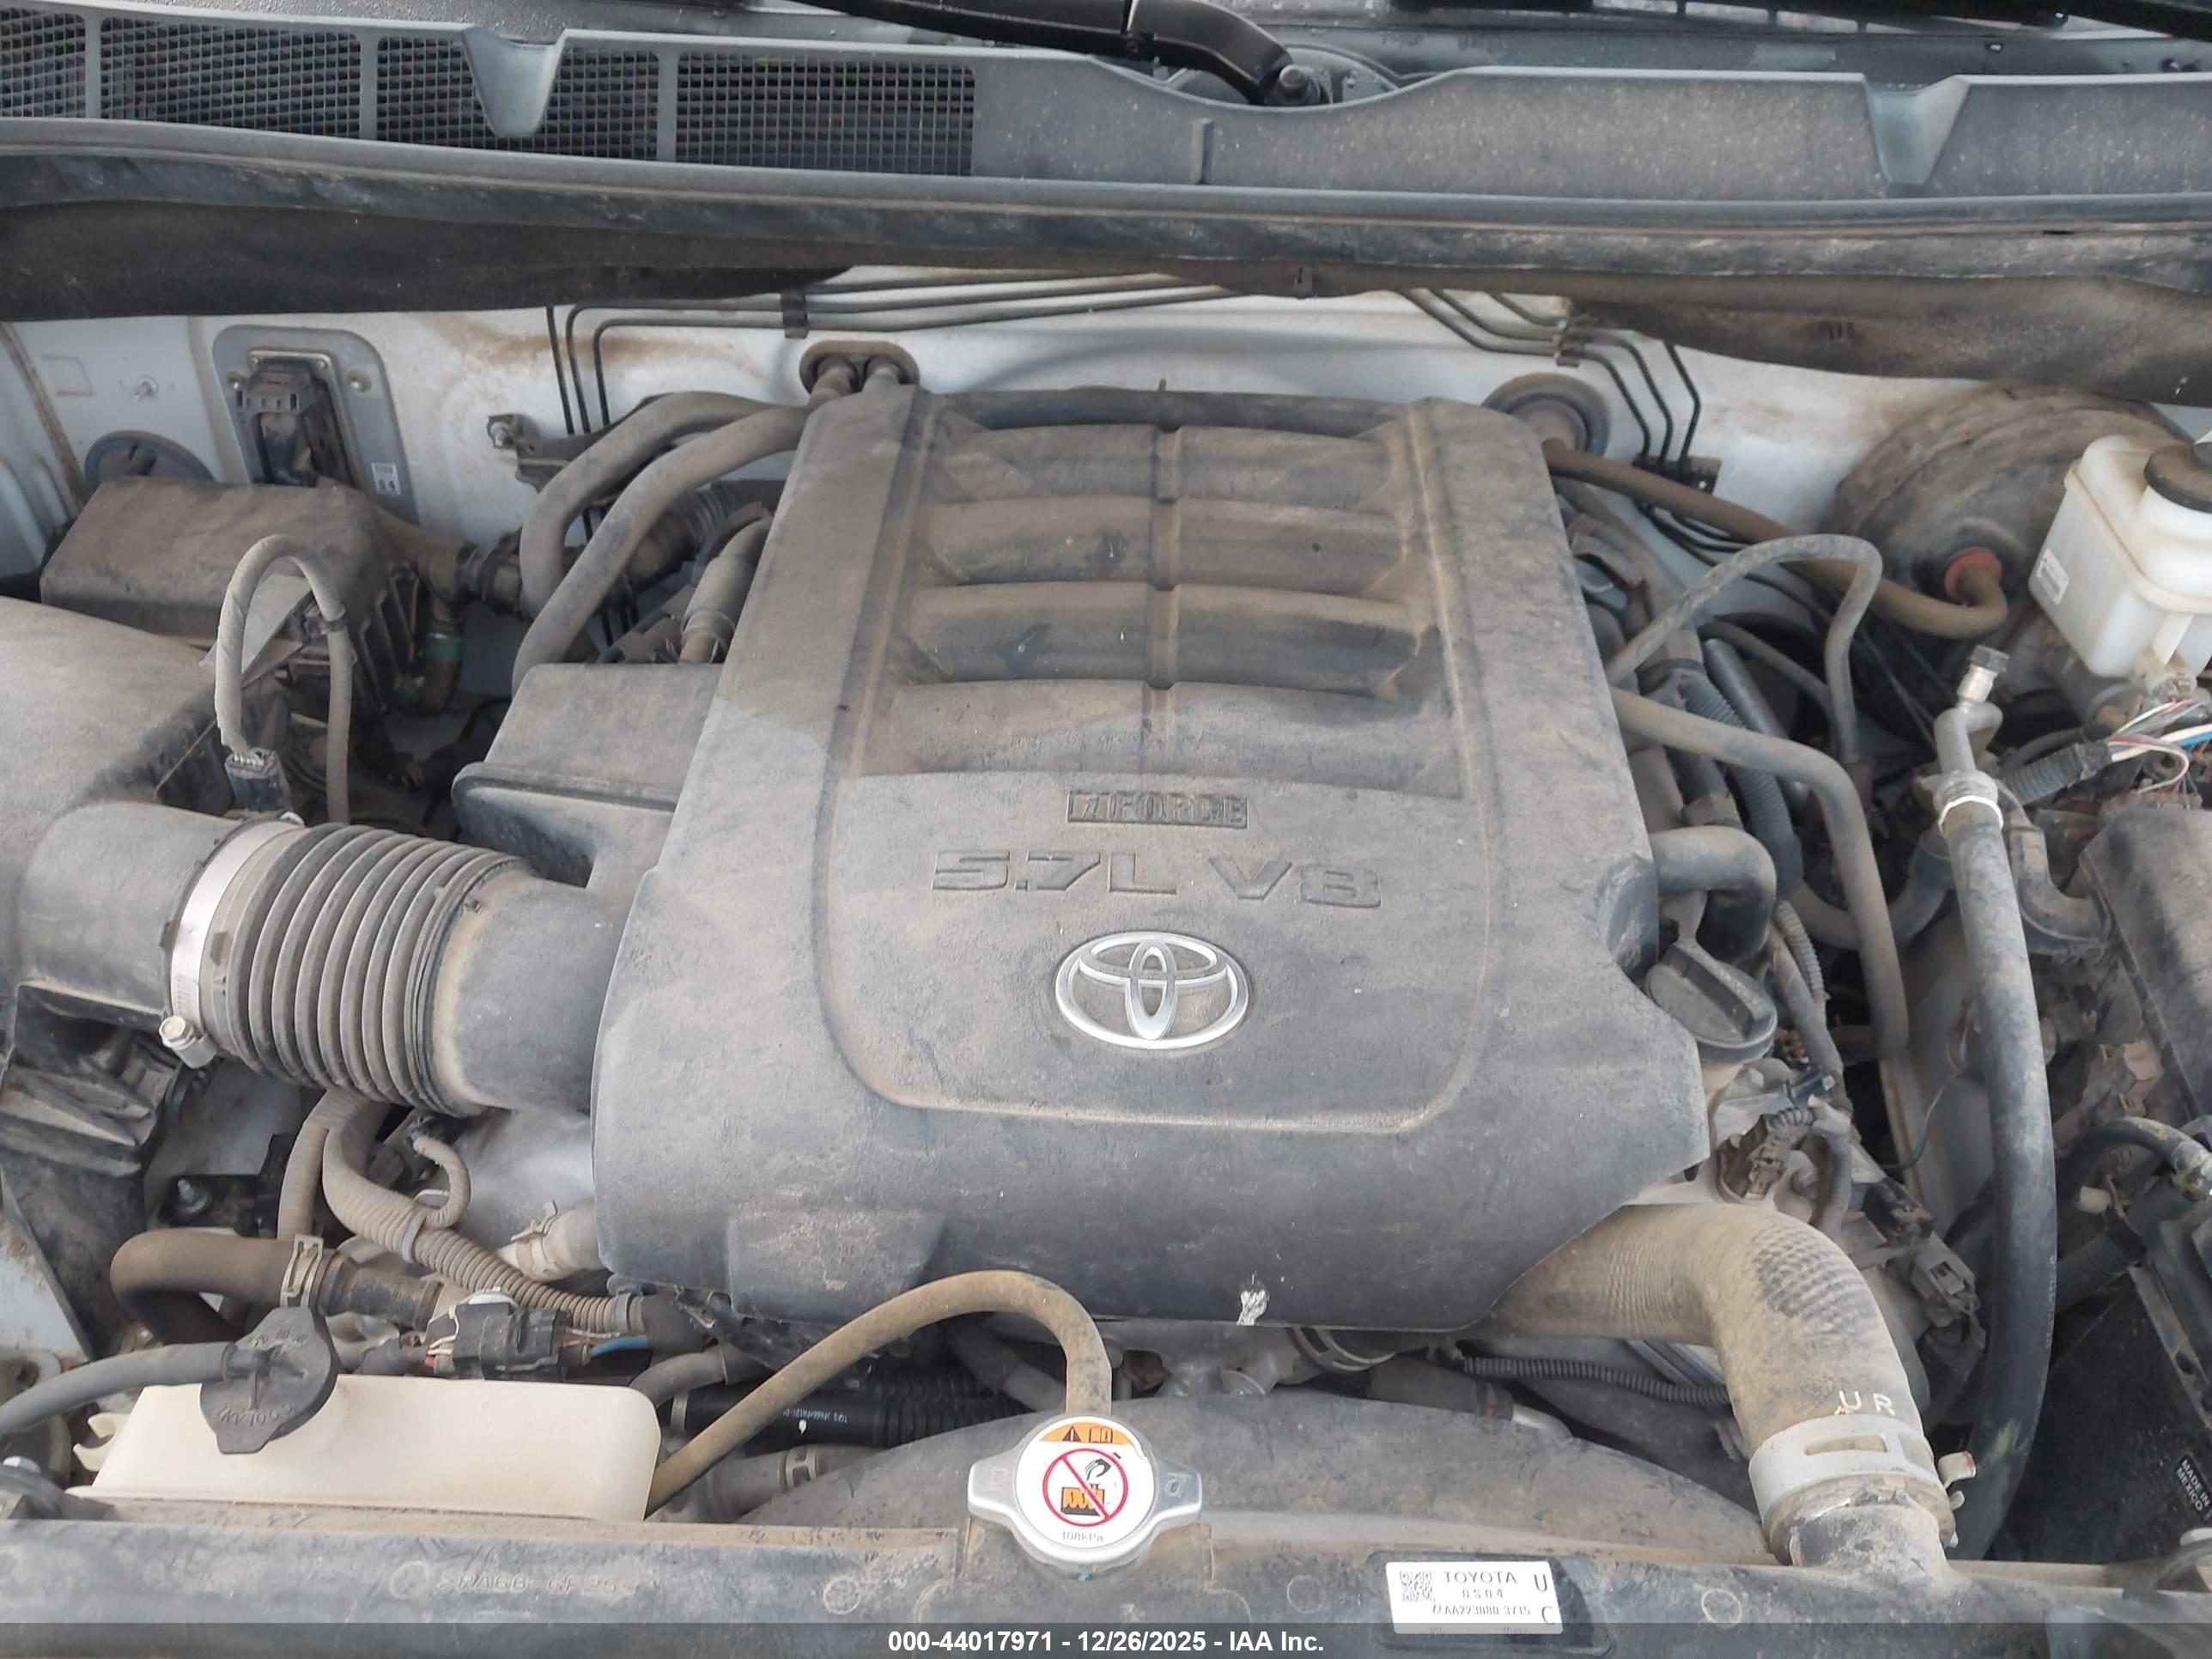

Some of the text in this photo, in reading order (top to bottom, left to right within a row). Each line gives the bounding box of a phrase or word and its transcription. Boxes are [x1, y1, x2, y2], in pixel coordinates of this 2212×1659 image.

[932, 850, 1382, 908] 5.7L V8
[2177, 1467, 2203, 1511] MEXICO
[2182, 1459, 2210, 1507] MADE IN
[1443, 1571, 1517, 1584] TOYOTA
[1533, 1573, 1548, 1592] U
[1540, 1605, 1556, 1626] C
